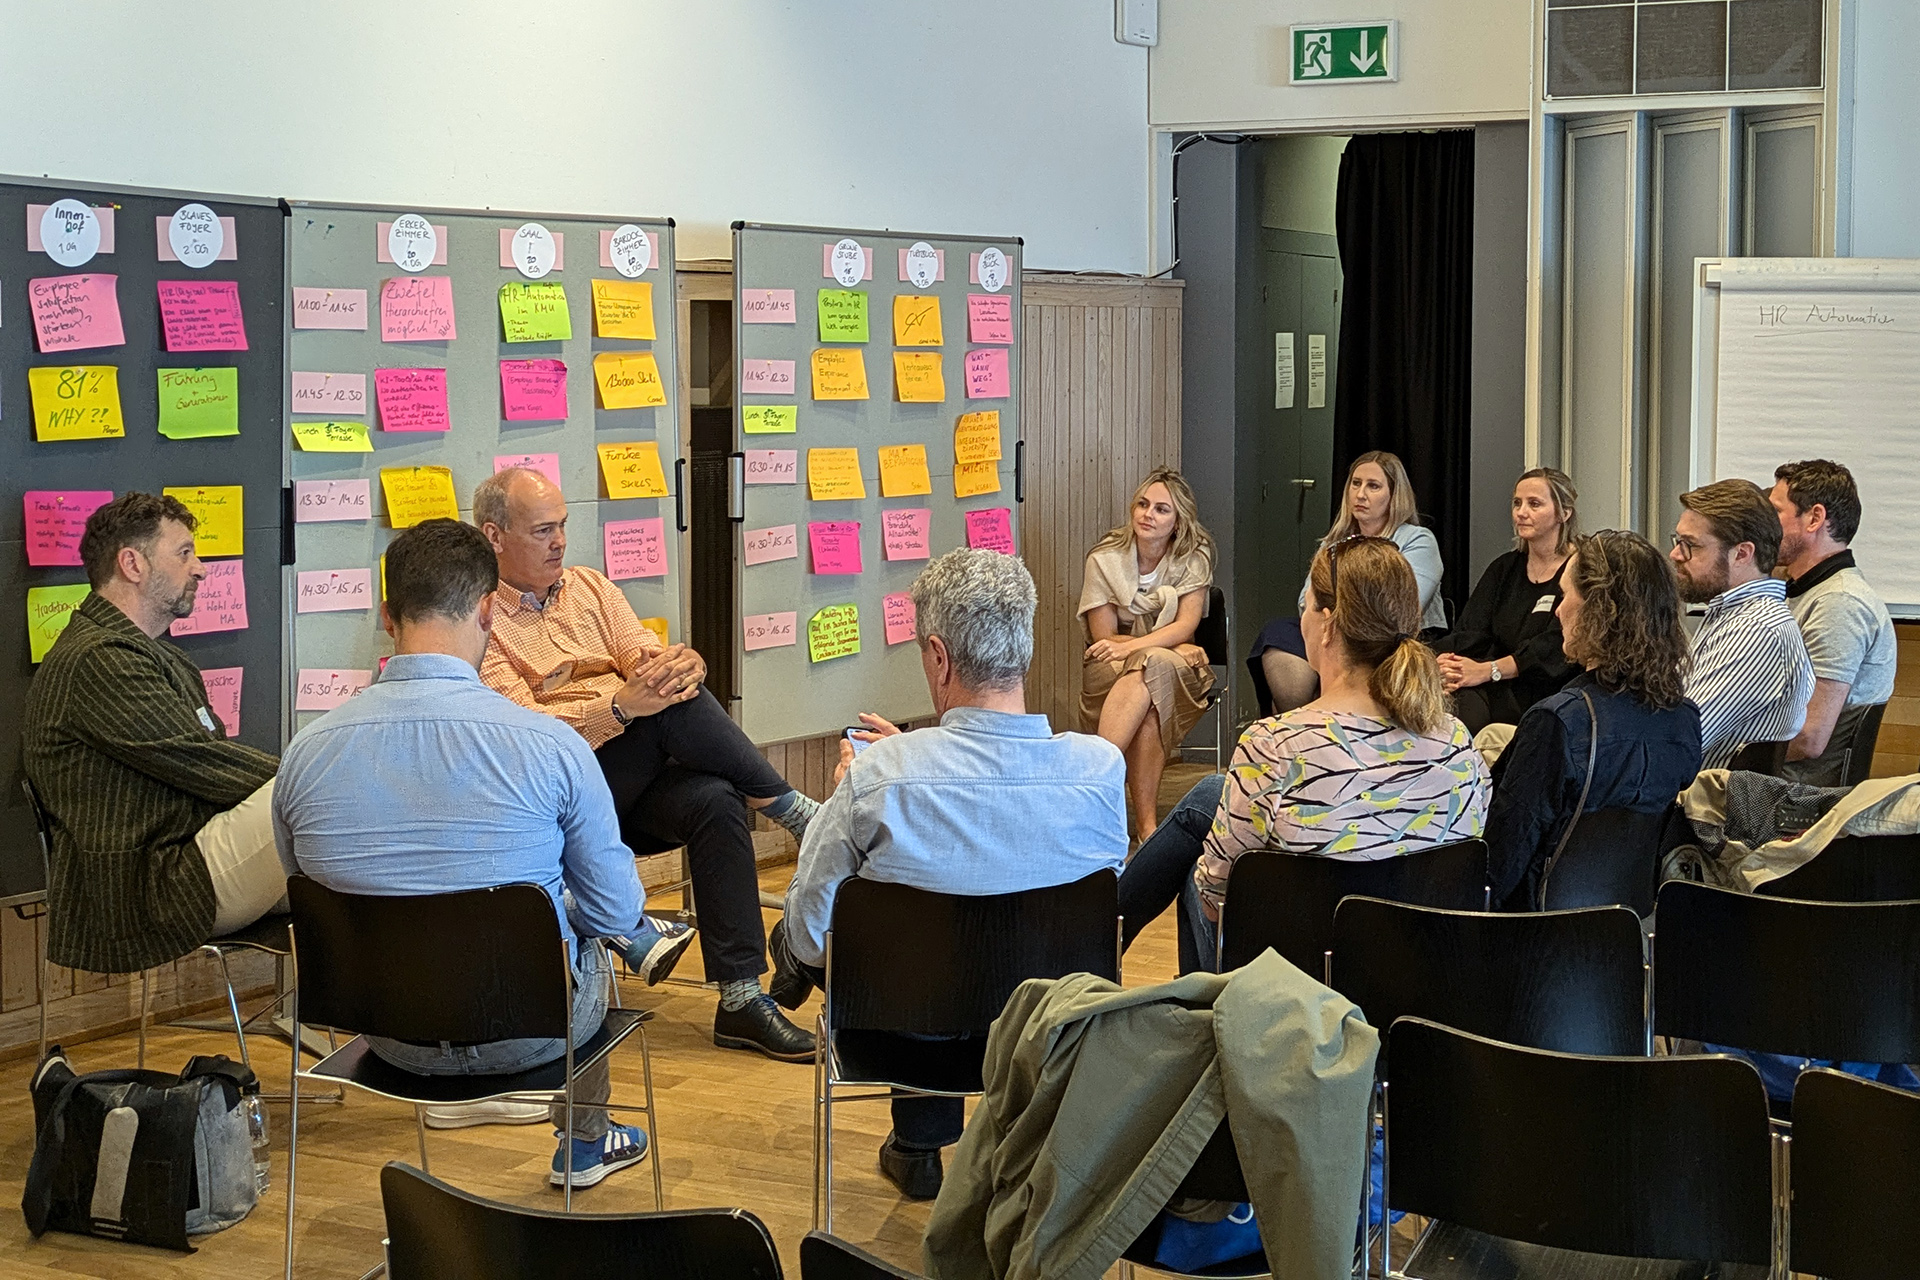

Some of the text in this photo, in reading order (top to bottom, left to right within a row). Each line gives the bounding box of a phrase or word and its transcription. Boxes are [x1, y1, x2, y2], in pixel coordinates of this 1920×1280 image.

[179, 223, 212, 233] FOYER
[399, 219, 426, 230] ERKER
[519, 229, 543, 239] SAAL
[534, 303, 555, 314] KMU
[1760, 304, 1788, 326] HR
[971, 353, 984, 361] WAS
[163, 372, 217, 392] Führung
[48, 408, 86, 428] WHY
[605, 450, 641, 460] FUTURE
[621, 478, 651, 488] SKILLS
